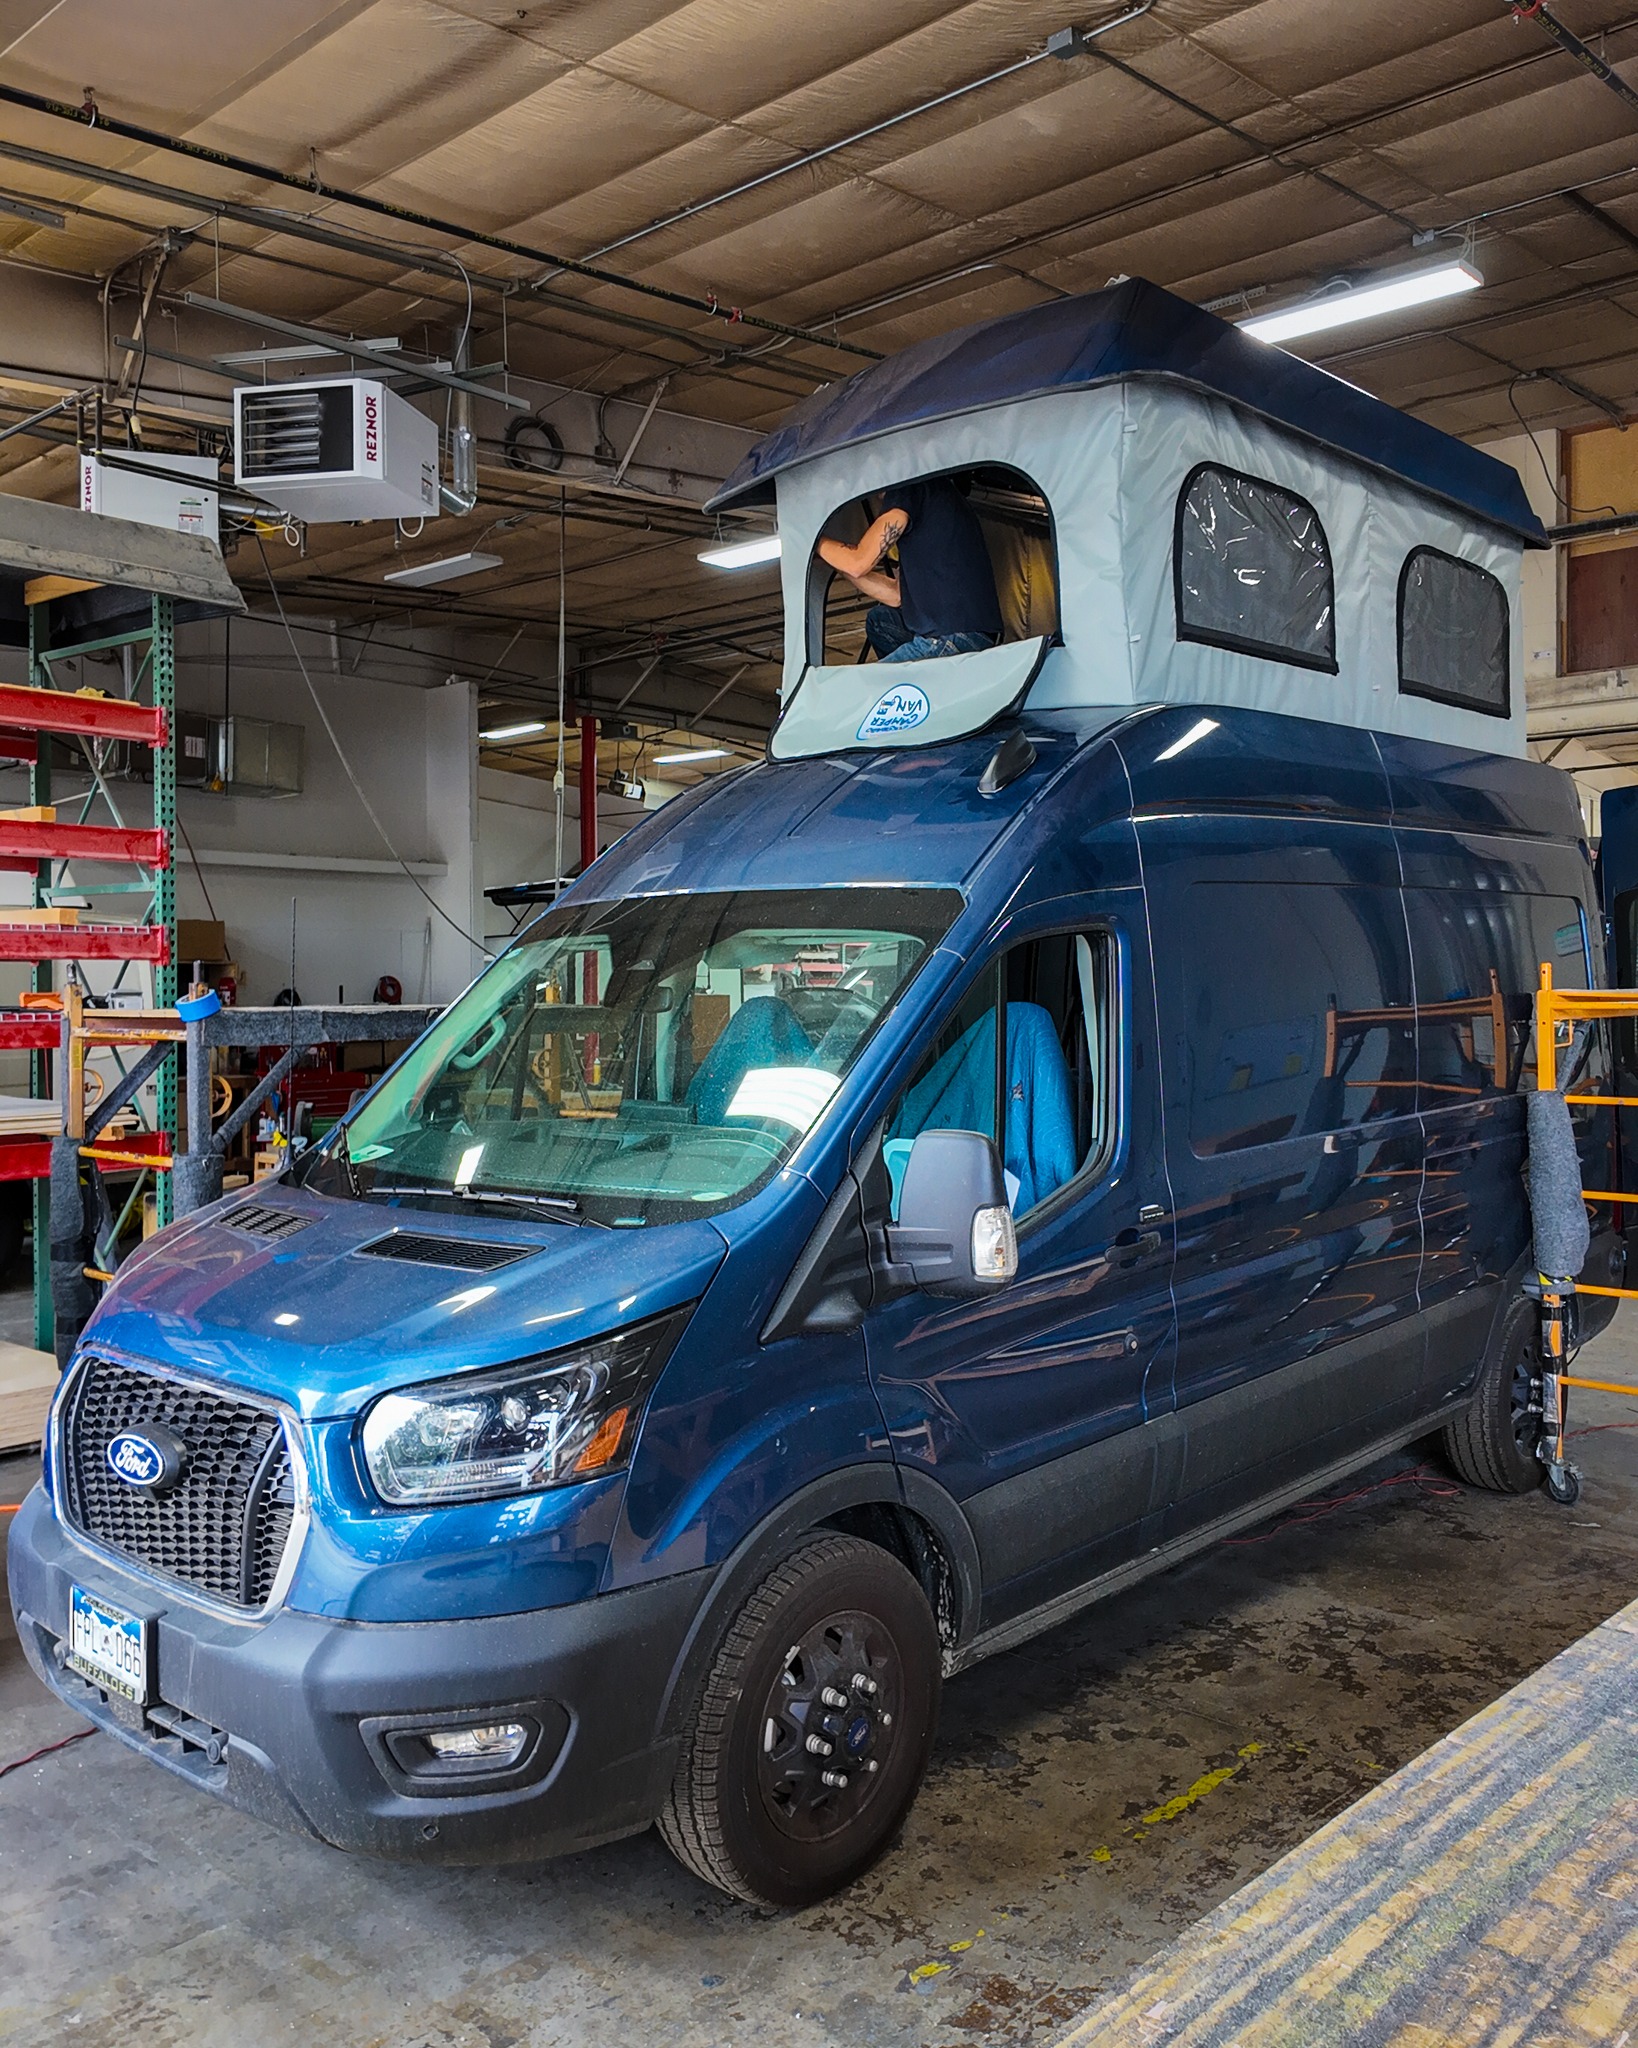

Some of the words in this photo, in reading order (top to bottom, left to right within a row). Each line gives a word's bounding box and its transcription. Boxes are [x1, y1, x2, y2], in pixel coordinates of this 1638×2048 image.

[366, 396, 377, 462] REZNOR
[84, 466, 92, 514] EZNOR
[870, 714, 919, 726] CAMPER
[893, 695, 922, 716] VAN
[115, 1440, 152, 1478] Ford
[73, 1655, 136, 1701] BUFFALOES
